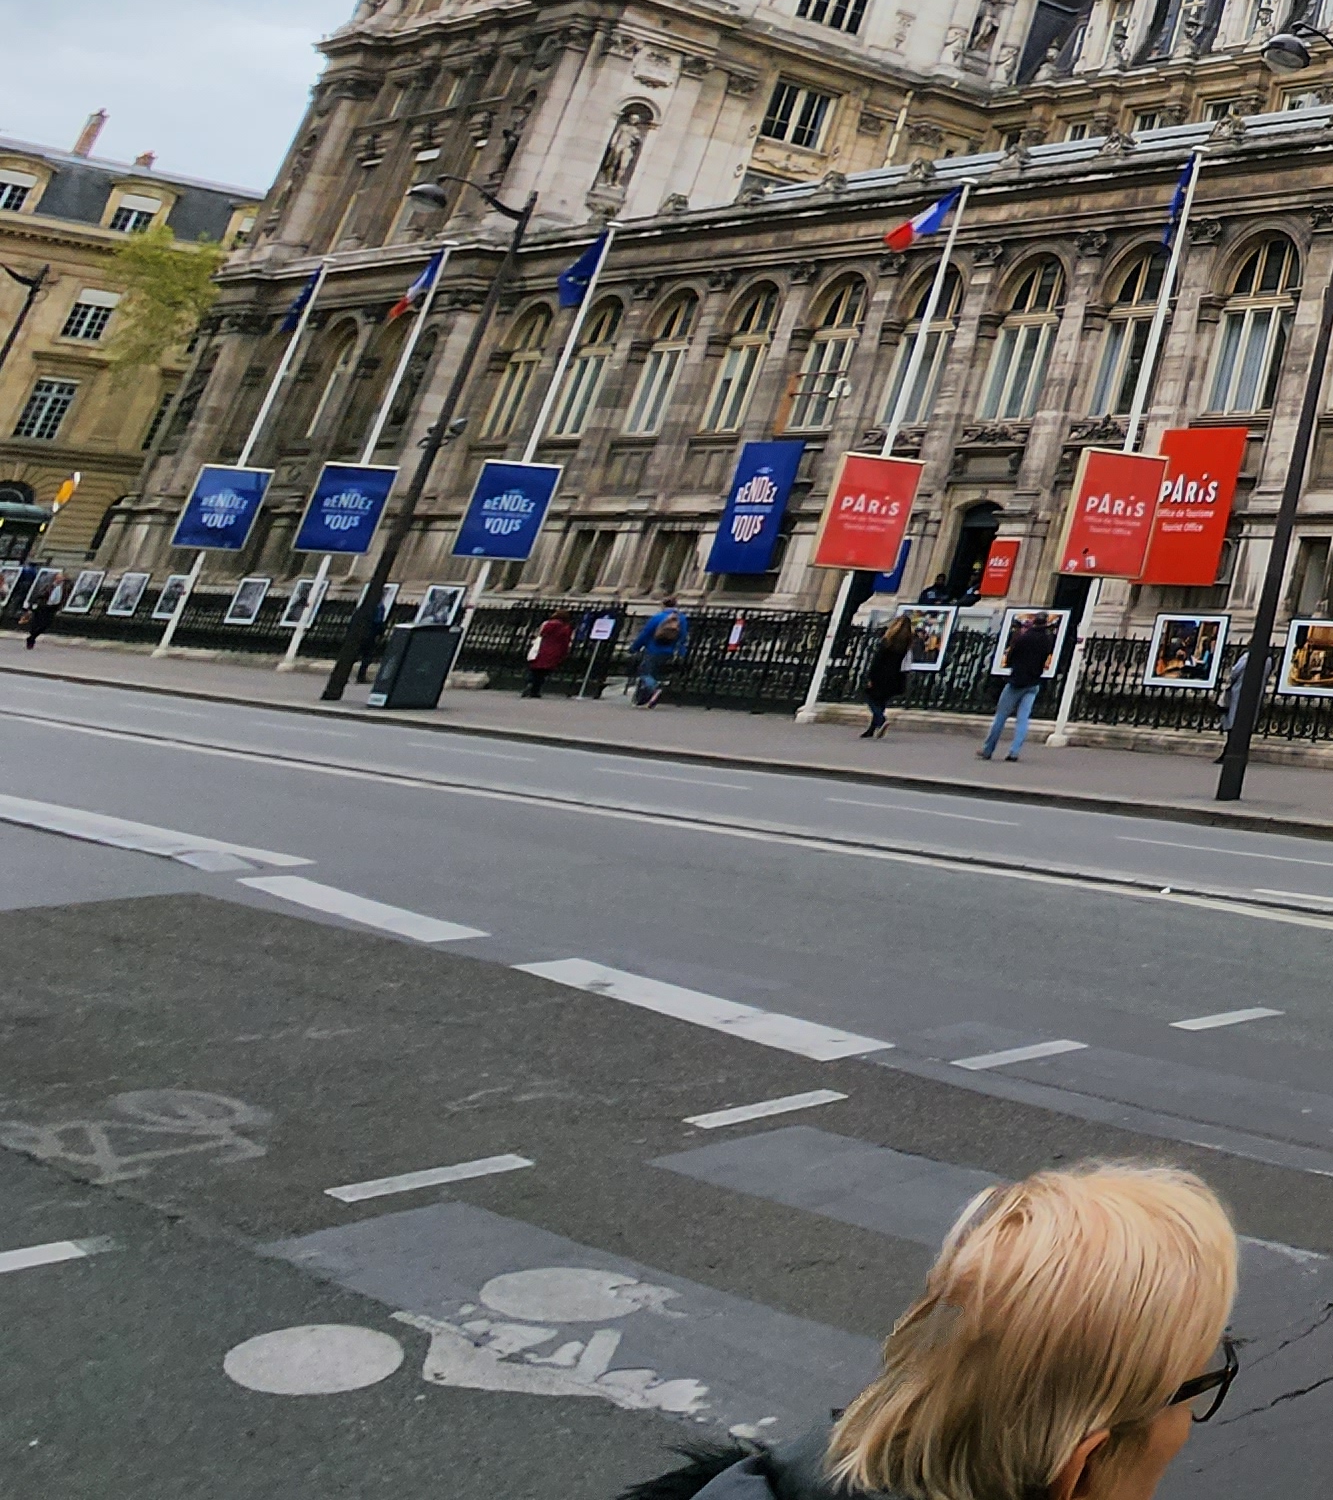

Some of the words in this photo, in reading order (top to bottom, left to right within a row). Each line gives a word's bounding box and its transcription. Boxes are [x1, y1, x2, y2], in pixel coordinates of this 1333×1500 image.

[324, 514, 361, 530] VOUS
[484, 517, 522, 535] VOUS
[731, 514, 765, 542] VOUS
